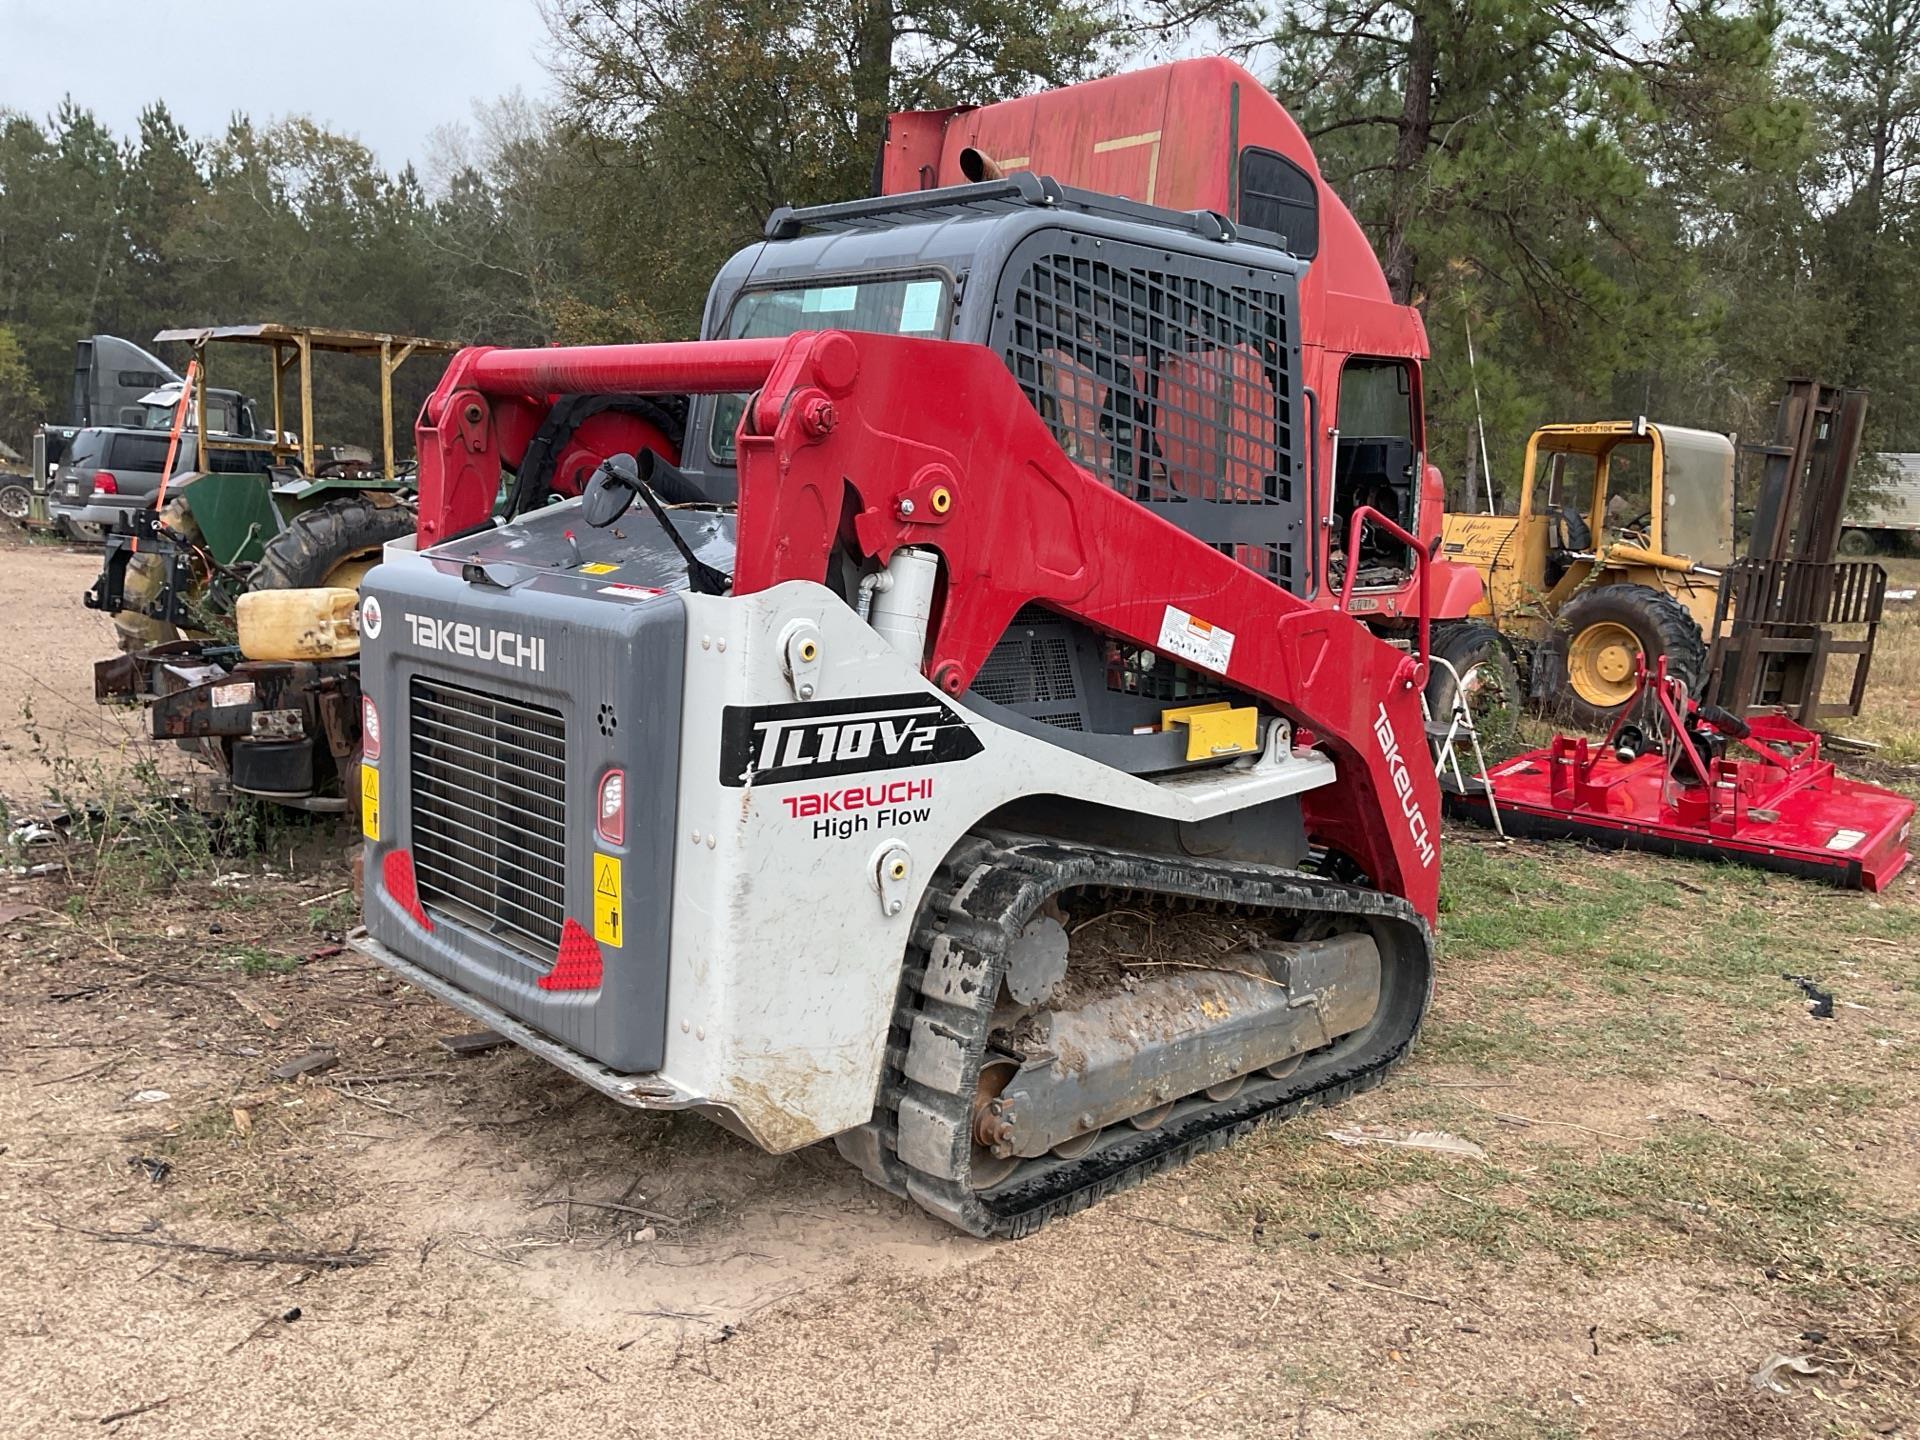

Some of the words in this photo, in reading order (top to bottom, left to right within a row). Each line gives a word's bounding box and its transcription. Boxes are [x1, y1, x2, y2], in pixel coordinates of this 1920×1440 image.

[404, 613, 545, 672] TAKEUCHI
[752, 705, 943, 771] TL10V2
[782, 779, 933, 818] TAKEUCHI
[1373, 702, 1436, 868] TAKEUCHI
[813, 814, 868, 840] High
[877, 807, 931, 829] Flow
